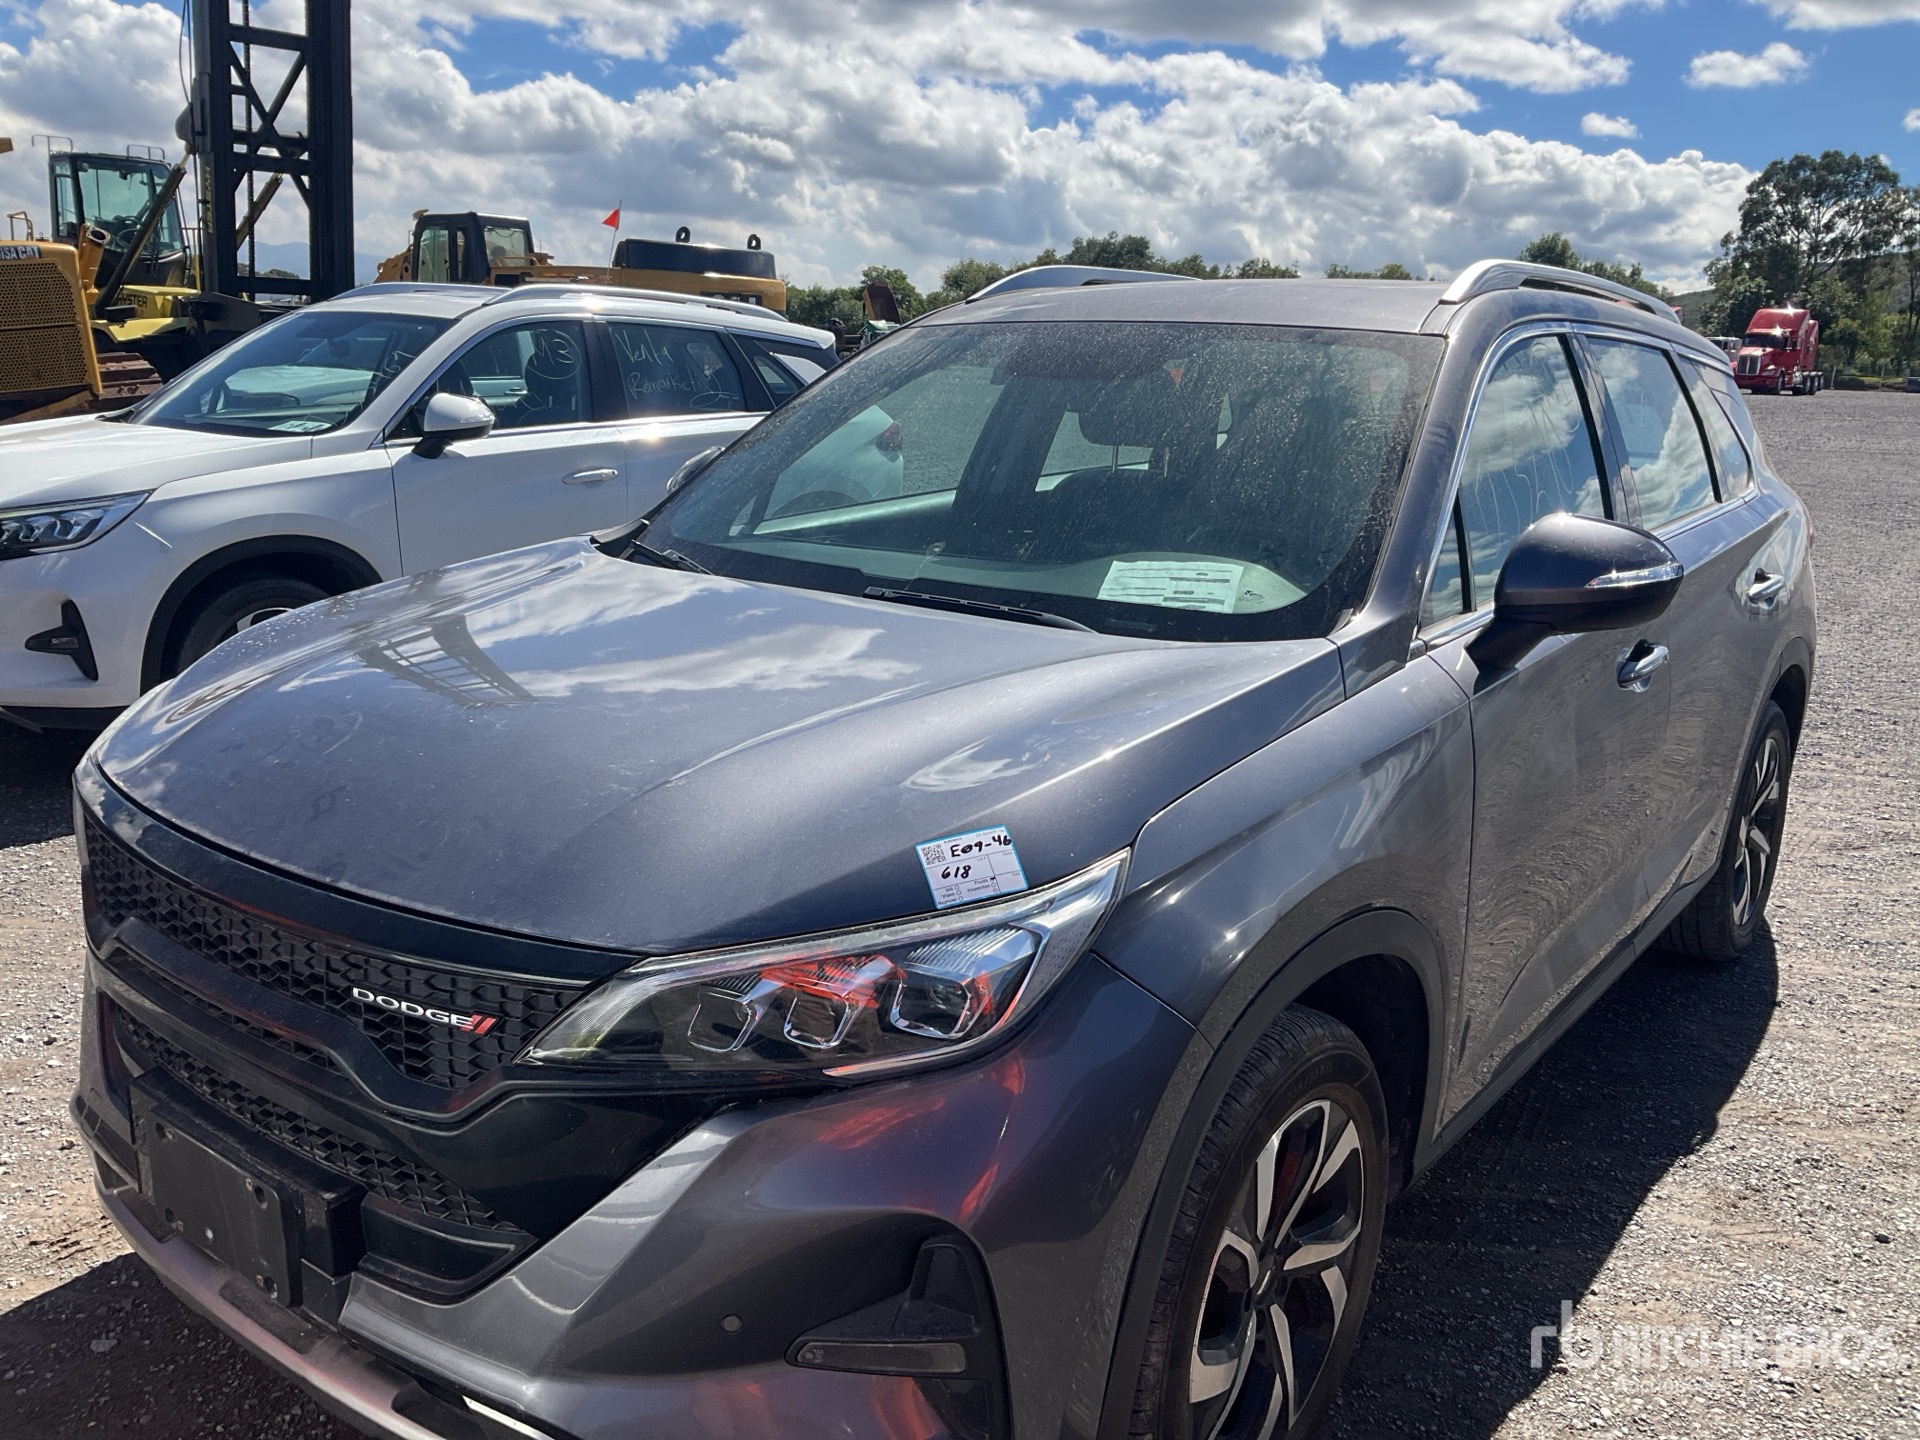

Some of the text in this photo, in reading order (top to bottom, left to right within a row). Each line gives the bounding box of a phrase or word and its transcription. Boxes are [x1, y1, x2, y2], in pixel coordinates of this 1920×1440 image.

[17, 245, 39, 260] CAT
[615, 327, 674, 364] Venta
[949, 834, 1012, 858] E09-46
[941, 864, 972, 879] 618
[352, 986, 475, 1030] DODGE
